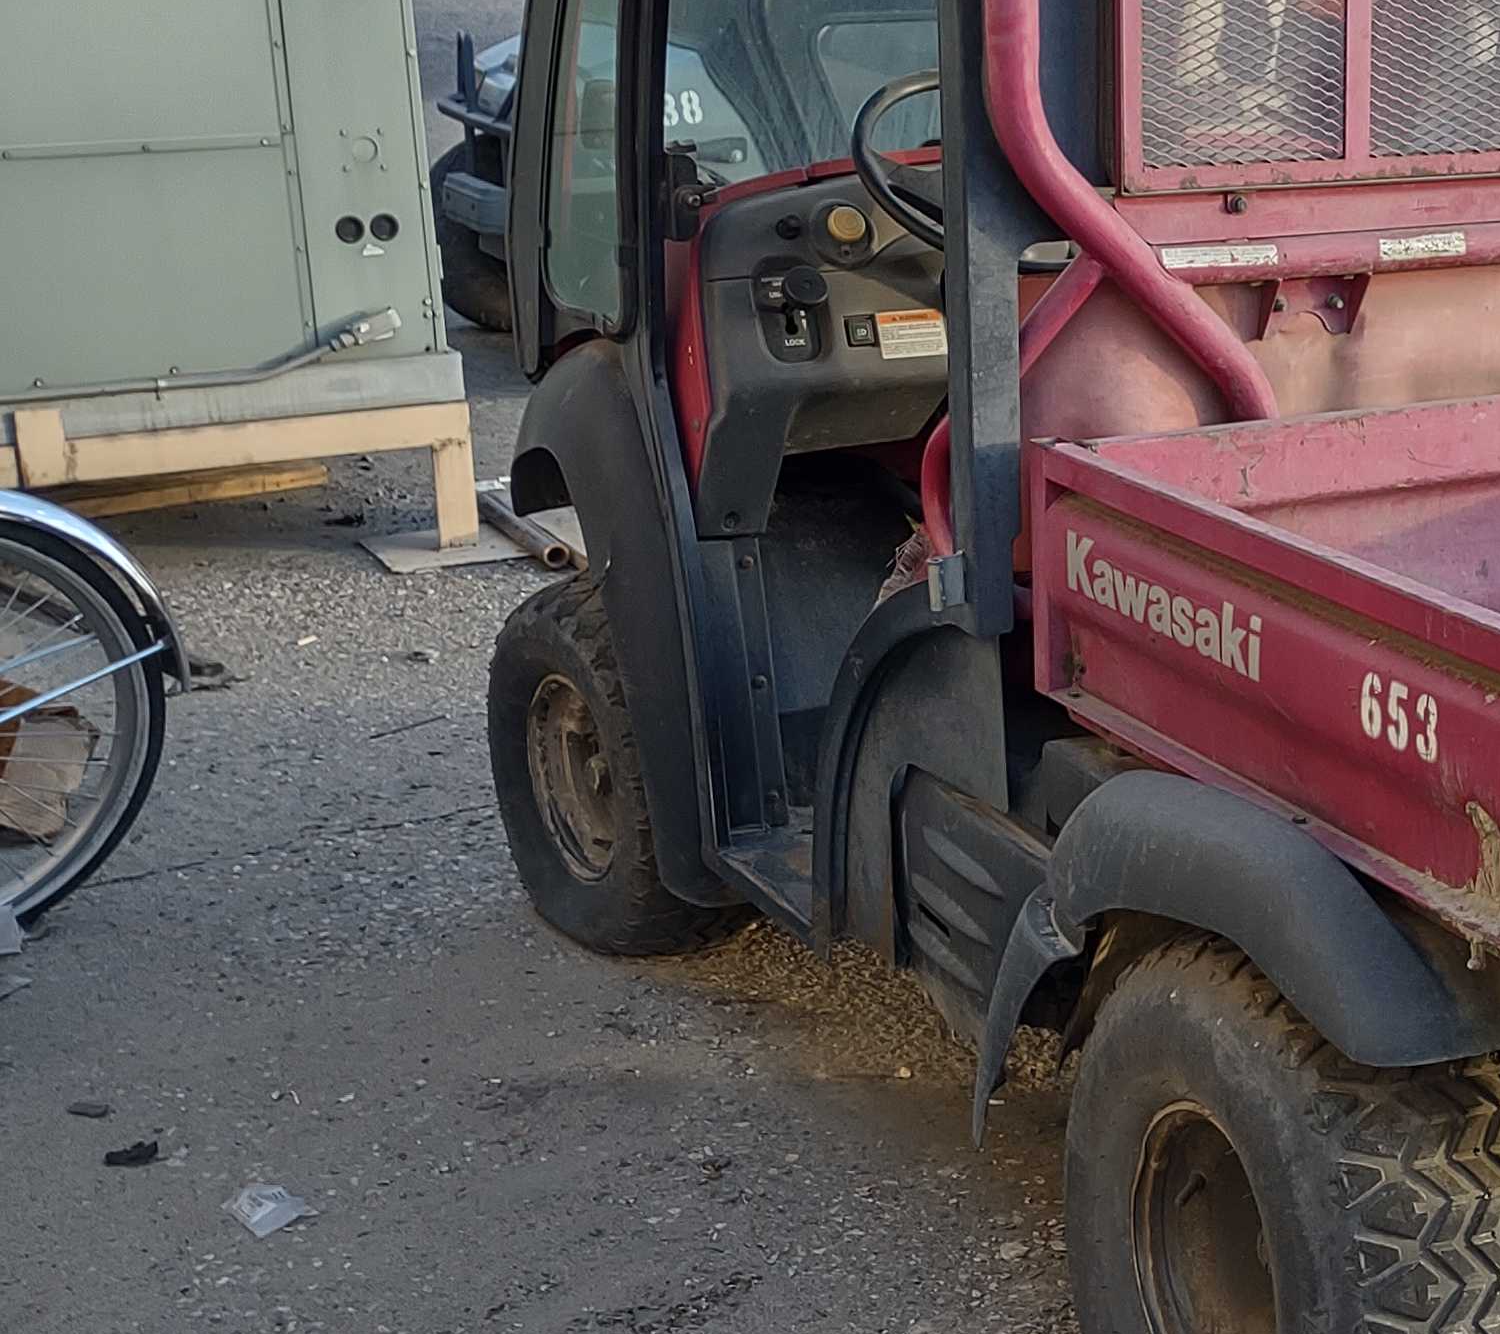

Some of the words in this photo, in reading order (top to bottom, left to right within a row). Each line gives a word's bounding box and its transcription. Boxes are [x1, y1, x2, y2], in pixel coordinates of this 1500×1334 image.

[784, 338, 807, 347] LOCK
[1066, 529, 1262, 682] Kawasaki
[1360, 671, 1439, 763] 653
